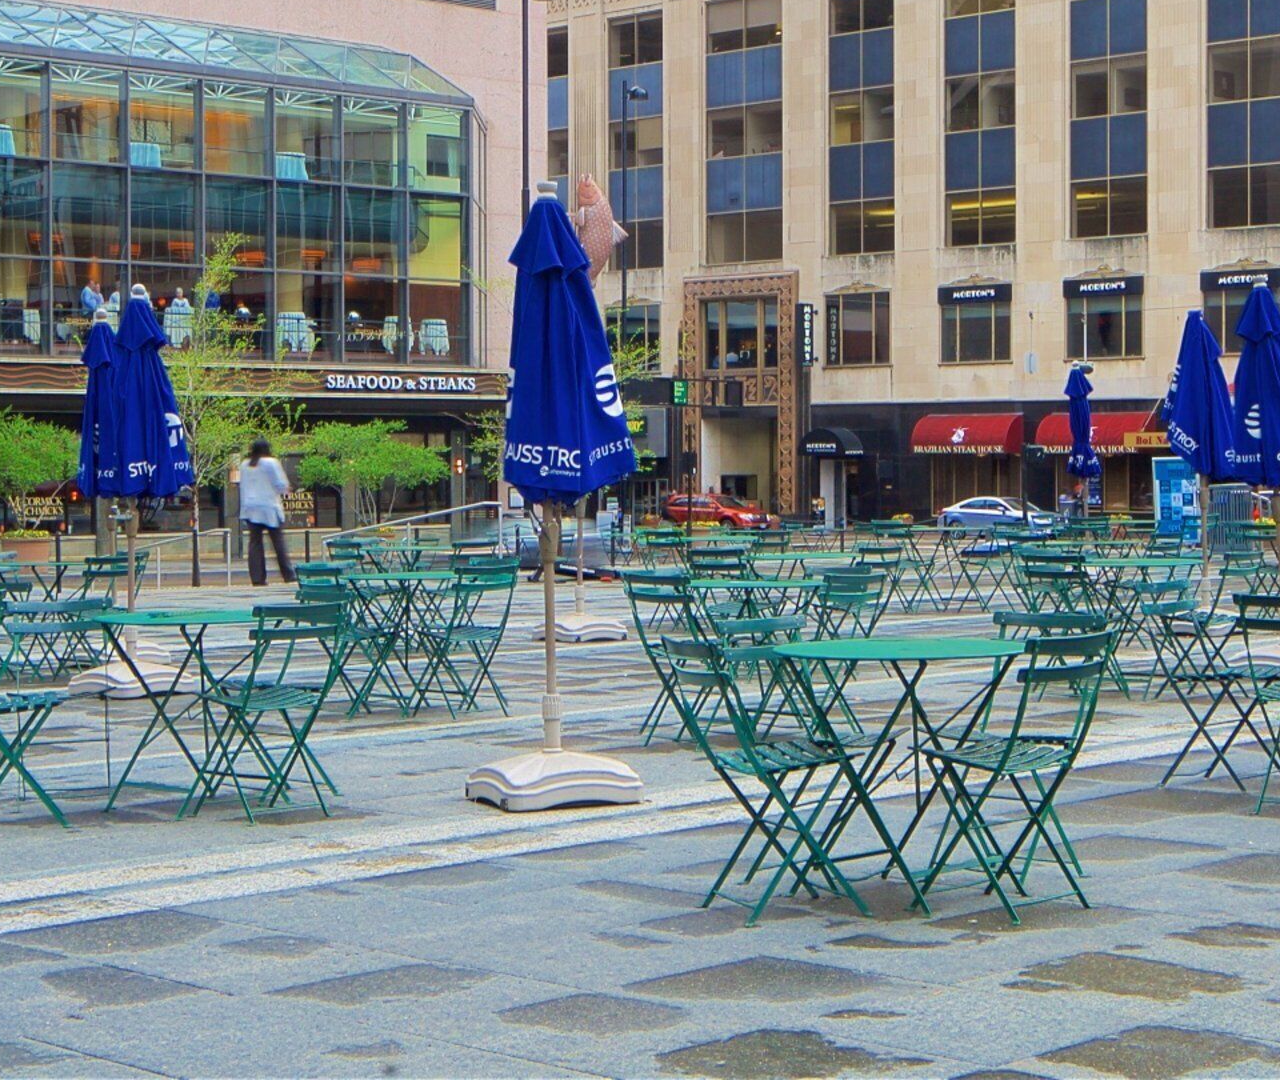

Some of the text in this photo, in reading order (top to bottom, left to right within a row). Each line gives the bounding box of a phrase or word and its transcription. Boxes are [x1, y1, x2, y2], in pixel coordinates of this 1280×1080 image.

[1080, 281, 1126, 292] MORTON'S
[953, 288, 996, 299] MORTON'S
[327, 374, 476, 391] SEAFOOD & STEAKS
[914, 445, 1004, 454] BRAZILIAN STEAK HOUSE
